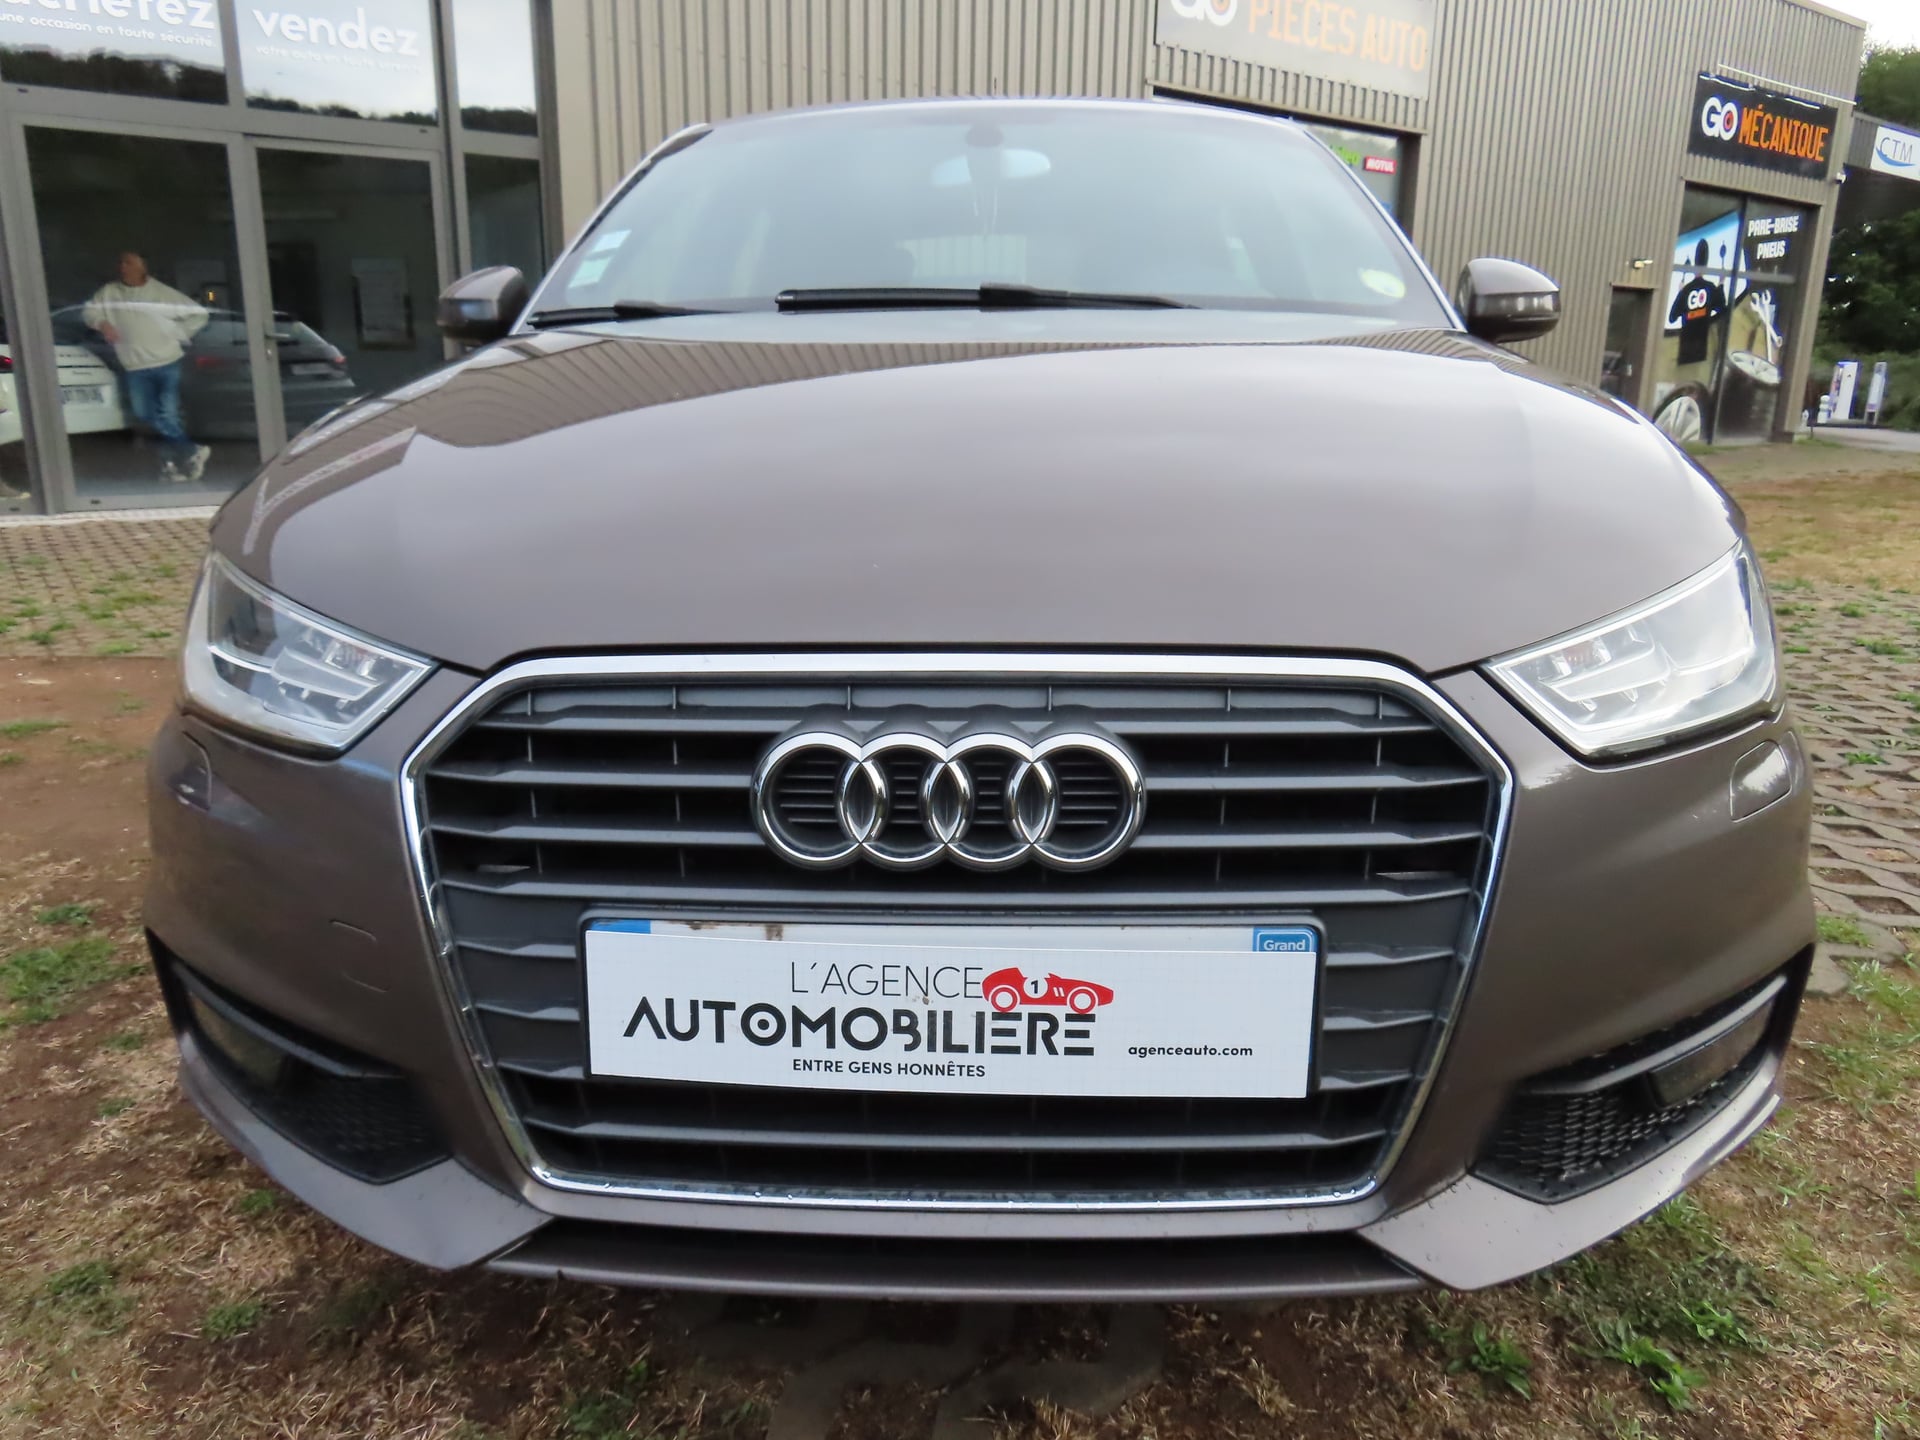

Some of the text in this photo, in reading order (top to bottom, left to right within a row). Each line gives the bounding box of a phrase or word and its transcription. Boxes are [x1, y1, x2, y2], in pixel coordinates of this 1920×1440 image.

[29, 16, 92, 32] occasion
[96, 24, 114, 35] en
[118, 26, 155, 40] toute
[251, 7, 420, 57] vendez
[1361, 13, 1428, 72] AUTO
[1701, 96, 1829, 162] GO MÉCANIQUE
[1879, 136, 1914, 163] CTM
[1366, 157, 1395, 173] MOTUL
[1748, 215, 1799, 237] PARE-BRISE
[1757, 240, 1786, 259] PNEUS
[1687, 288, 1708, 310] GO
[1263, 939, 1306, 951] Grand
[790, 961, 984, 999] L'AGENCE
[1030, 979, 1040, 994] 1
[1127, 1043, 1253, 1058] agenceauto.com
[792, 1058, 986, 1078] ENTRE GENS HONNÊTES
